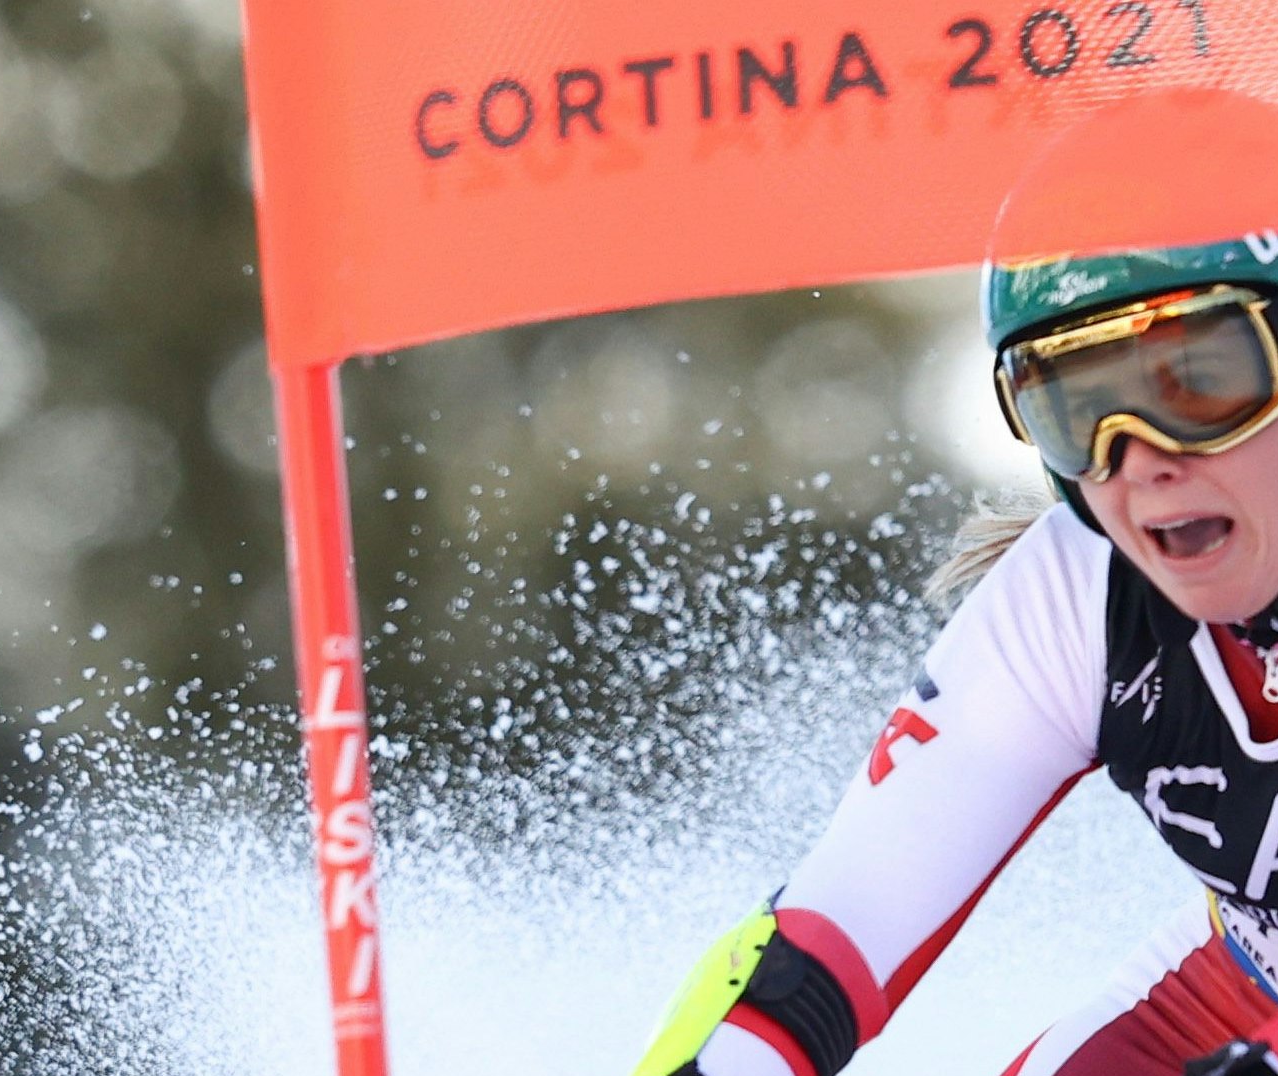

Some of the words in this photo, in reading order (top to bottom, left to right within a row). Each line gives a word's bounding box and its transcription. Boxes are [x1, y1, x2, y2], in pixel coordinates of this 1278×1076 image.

[414, 31, 889, 160] CORTINA
[946, 0, 1212, 88] 2021
[302, 665, 378, 998] LISKI
